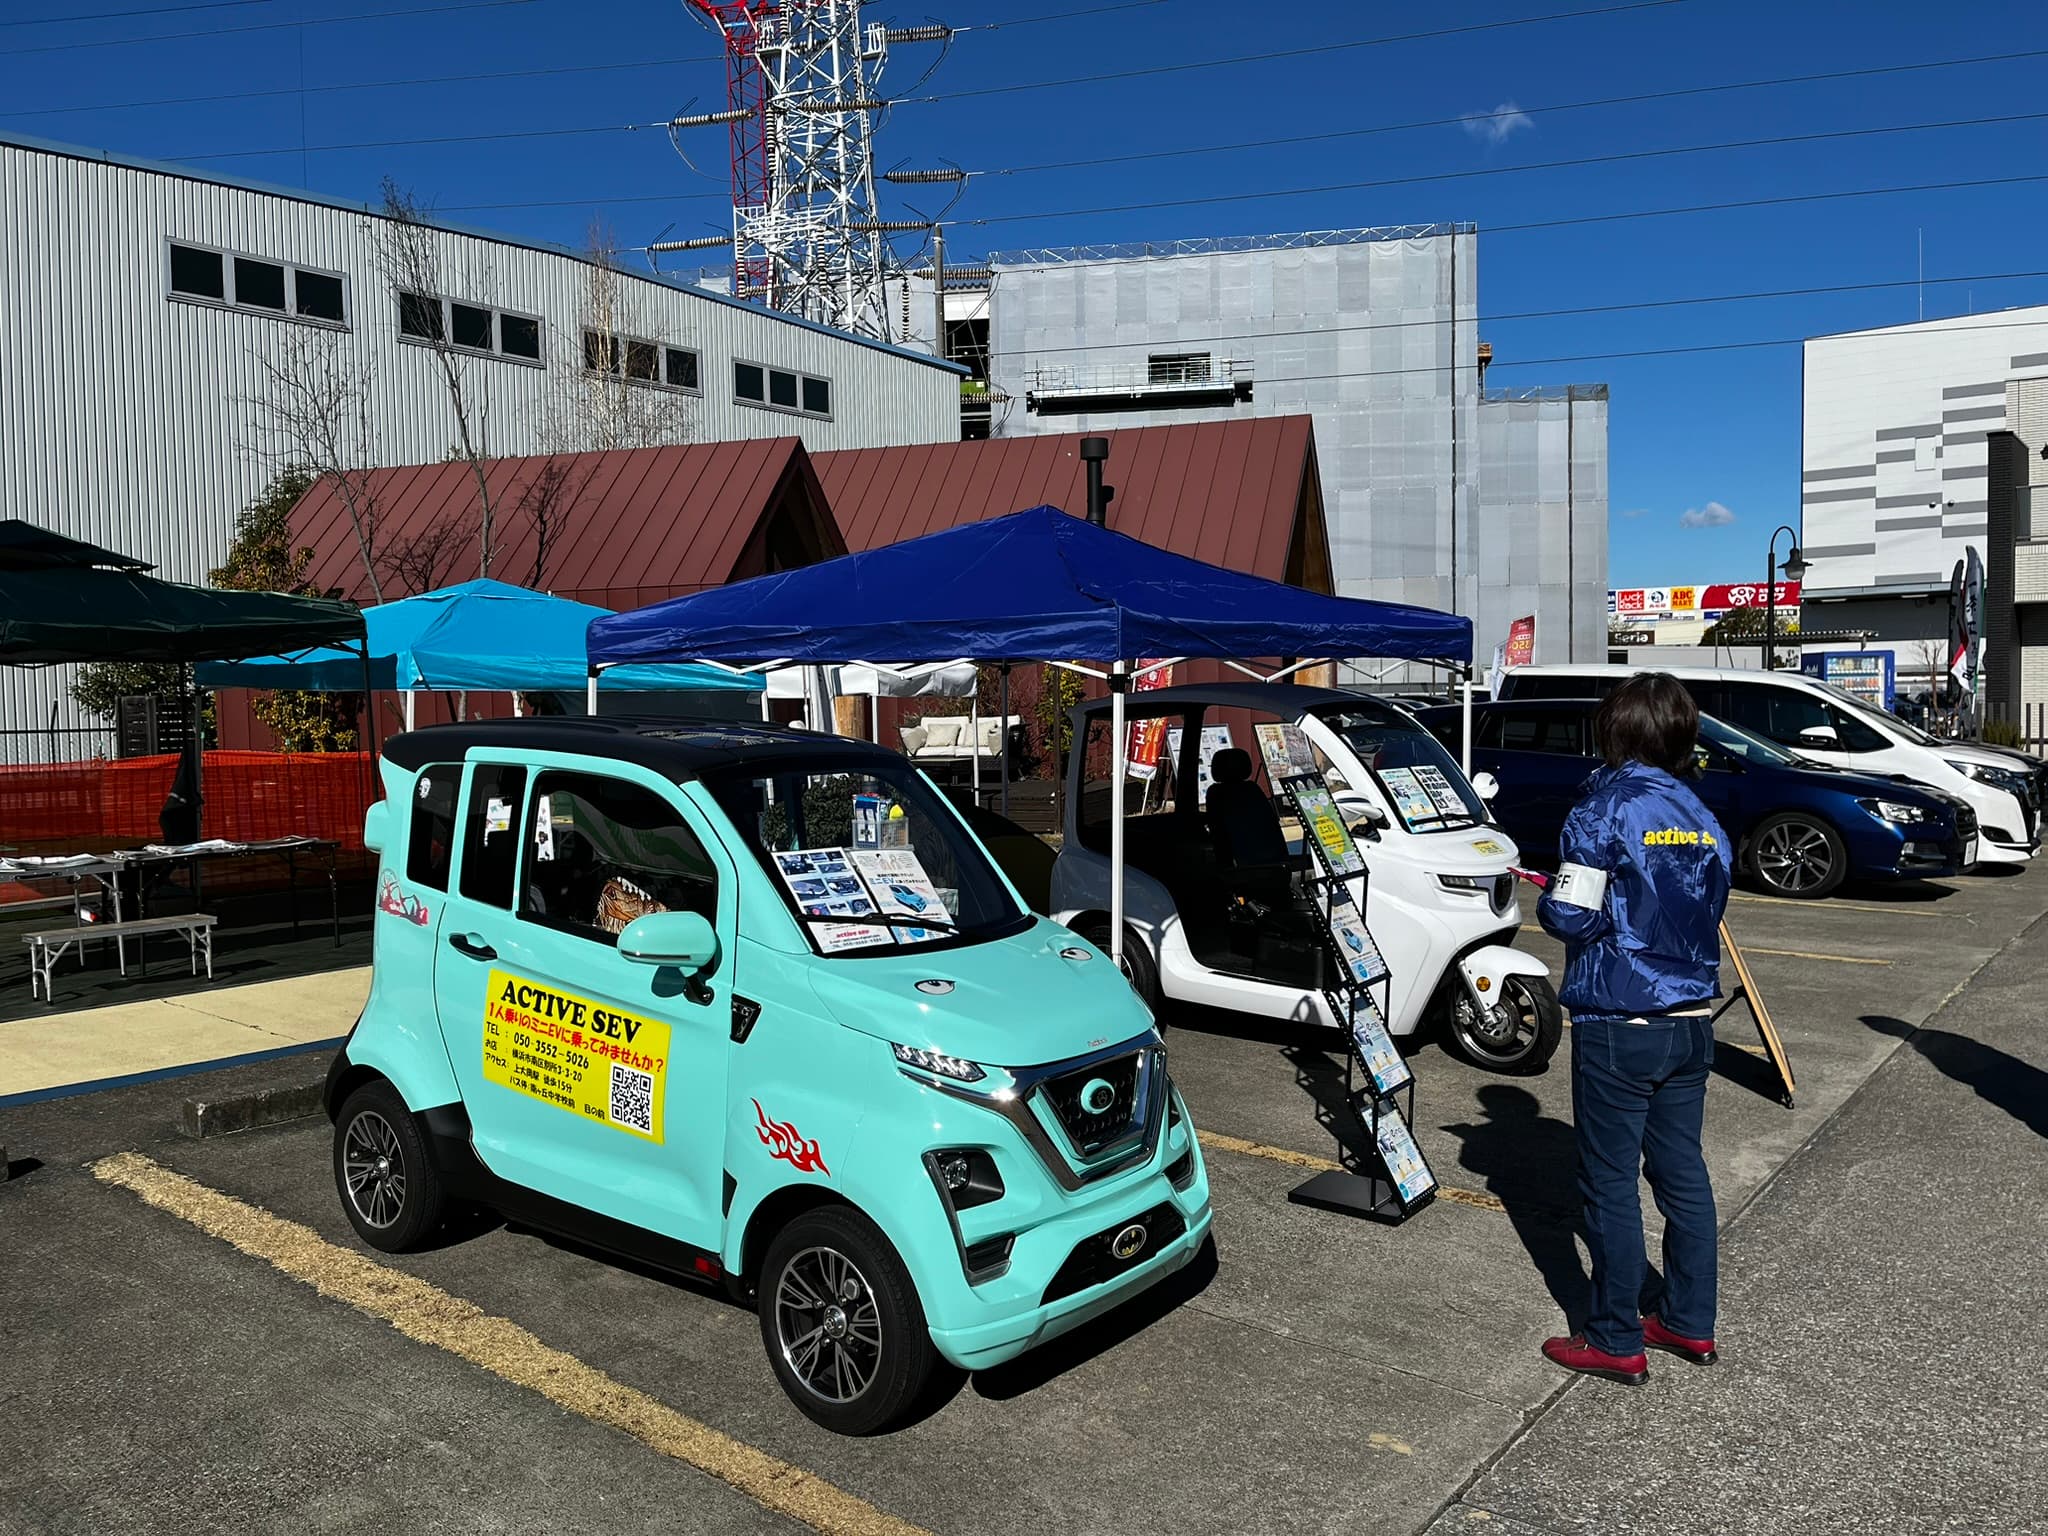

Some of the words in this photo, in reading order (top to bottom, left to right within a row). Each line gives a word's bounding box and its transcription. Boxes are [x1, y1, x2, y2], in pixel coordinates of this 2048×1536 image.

[1758, 593, 1785, 602] ロア
[1644, 826, 1698, 846] active
[501, 980, 587, 1028] ACTIVE
[591, 1008, 642, 1043] SEV
[486, 1021, 500, 1036] TEL
